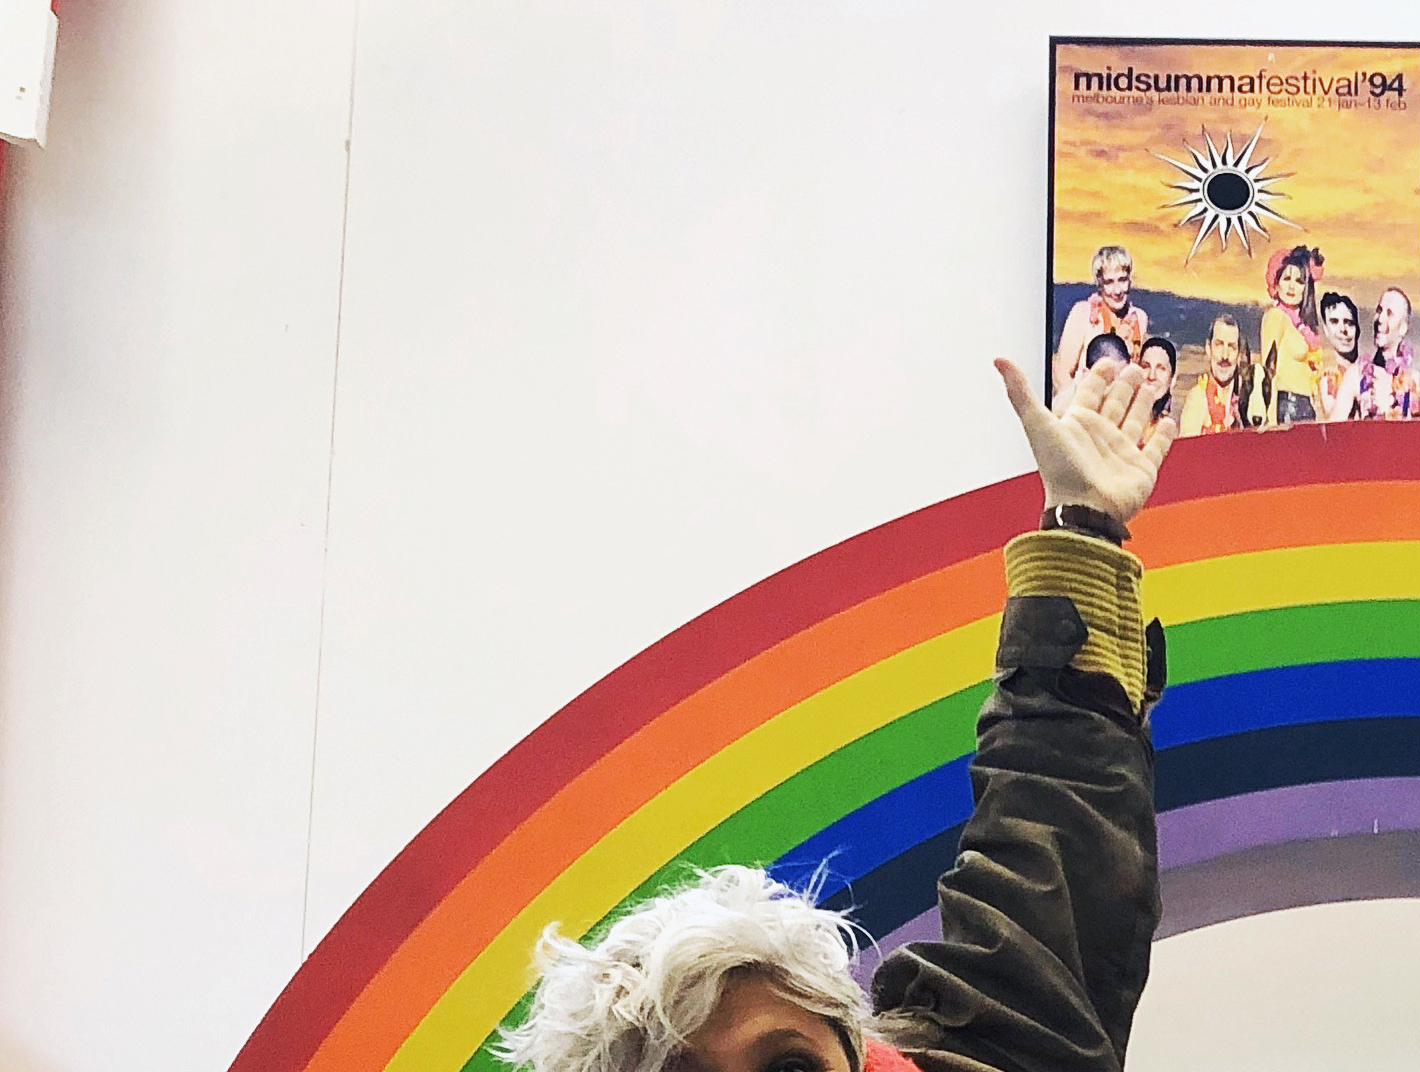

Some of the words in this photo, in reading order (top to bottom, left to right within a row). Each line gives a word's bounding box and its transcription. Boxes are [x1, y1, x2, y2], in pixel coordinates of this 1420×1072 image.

[1158, 93, 1204, 106] lesbian
[1209, 93, 1235, 107] and
[1238, 97, 1262, 110] gay
[1267, 96, 1312, 109] festival
[1317, 97, 1332, 109] 21
[1386, 97, 1407, 110] feb
